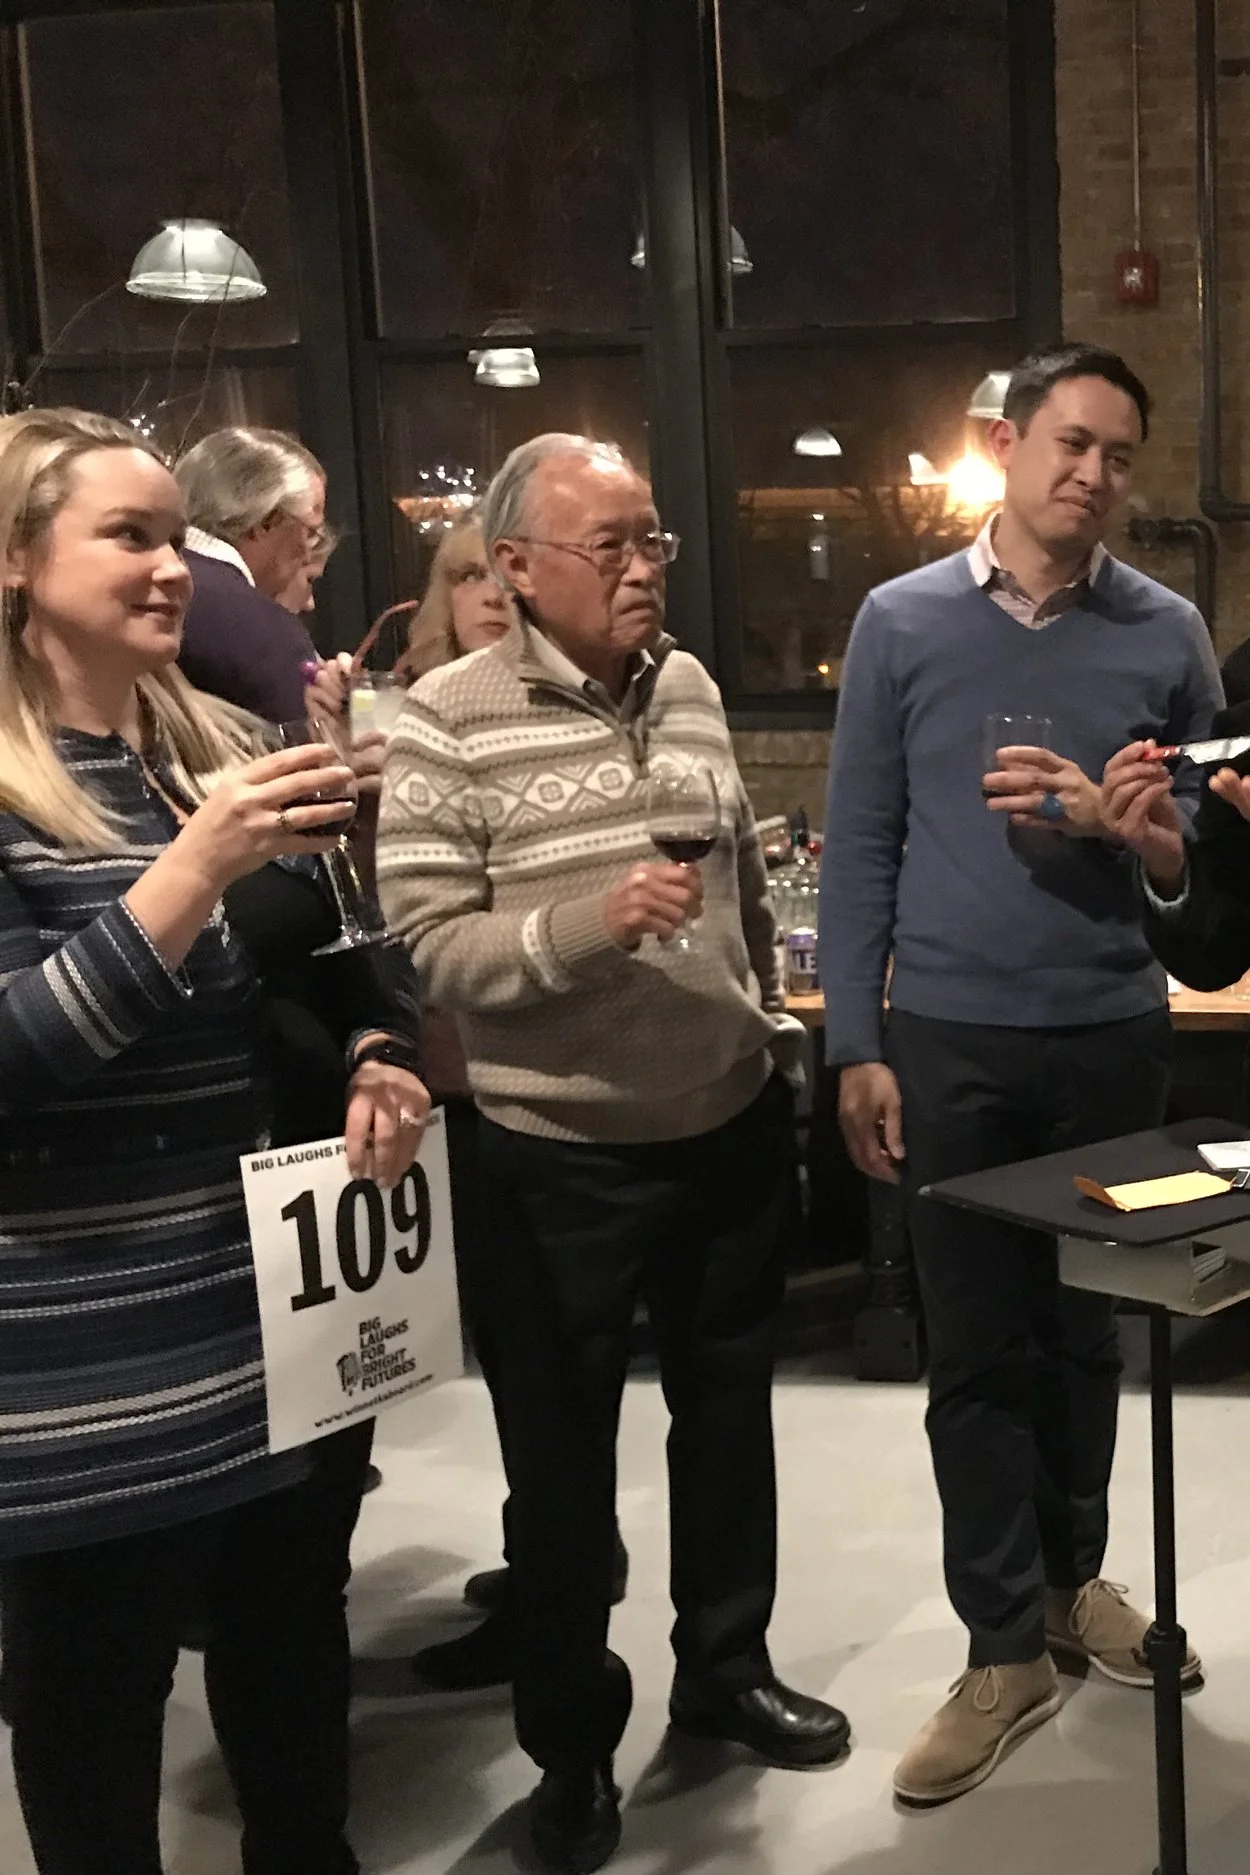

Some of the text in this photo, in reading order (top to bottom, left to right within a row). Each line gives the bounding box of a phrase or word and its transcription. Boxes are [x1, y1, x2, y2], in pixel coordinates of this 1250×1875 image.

[250, 1159, 274, 1172] BIG
[277, 1146, 333, 1167] LAUGHS
[280, 1161, 432, 1312] 109
[359, 1316, 381, 1335] BIG
[360, 1318, 409, 1349] LAUGHS
[361, 1343, 385, 1362] FOR
[362, 1347, 407, 1376] BRIGHT
[361, 1357, 416, 1391] FUTURES
